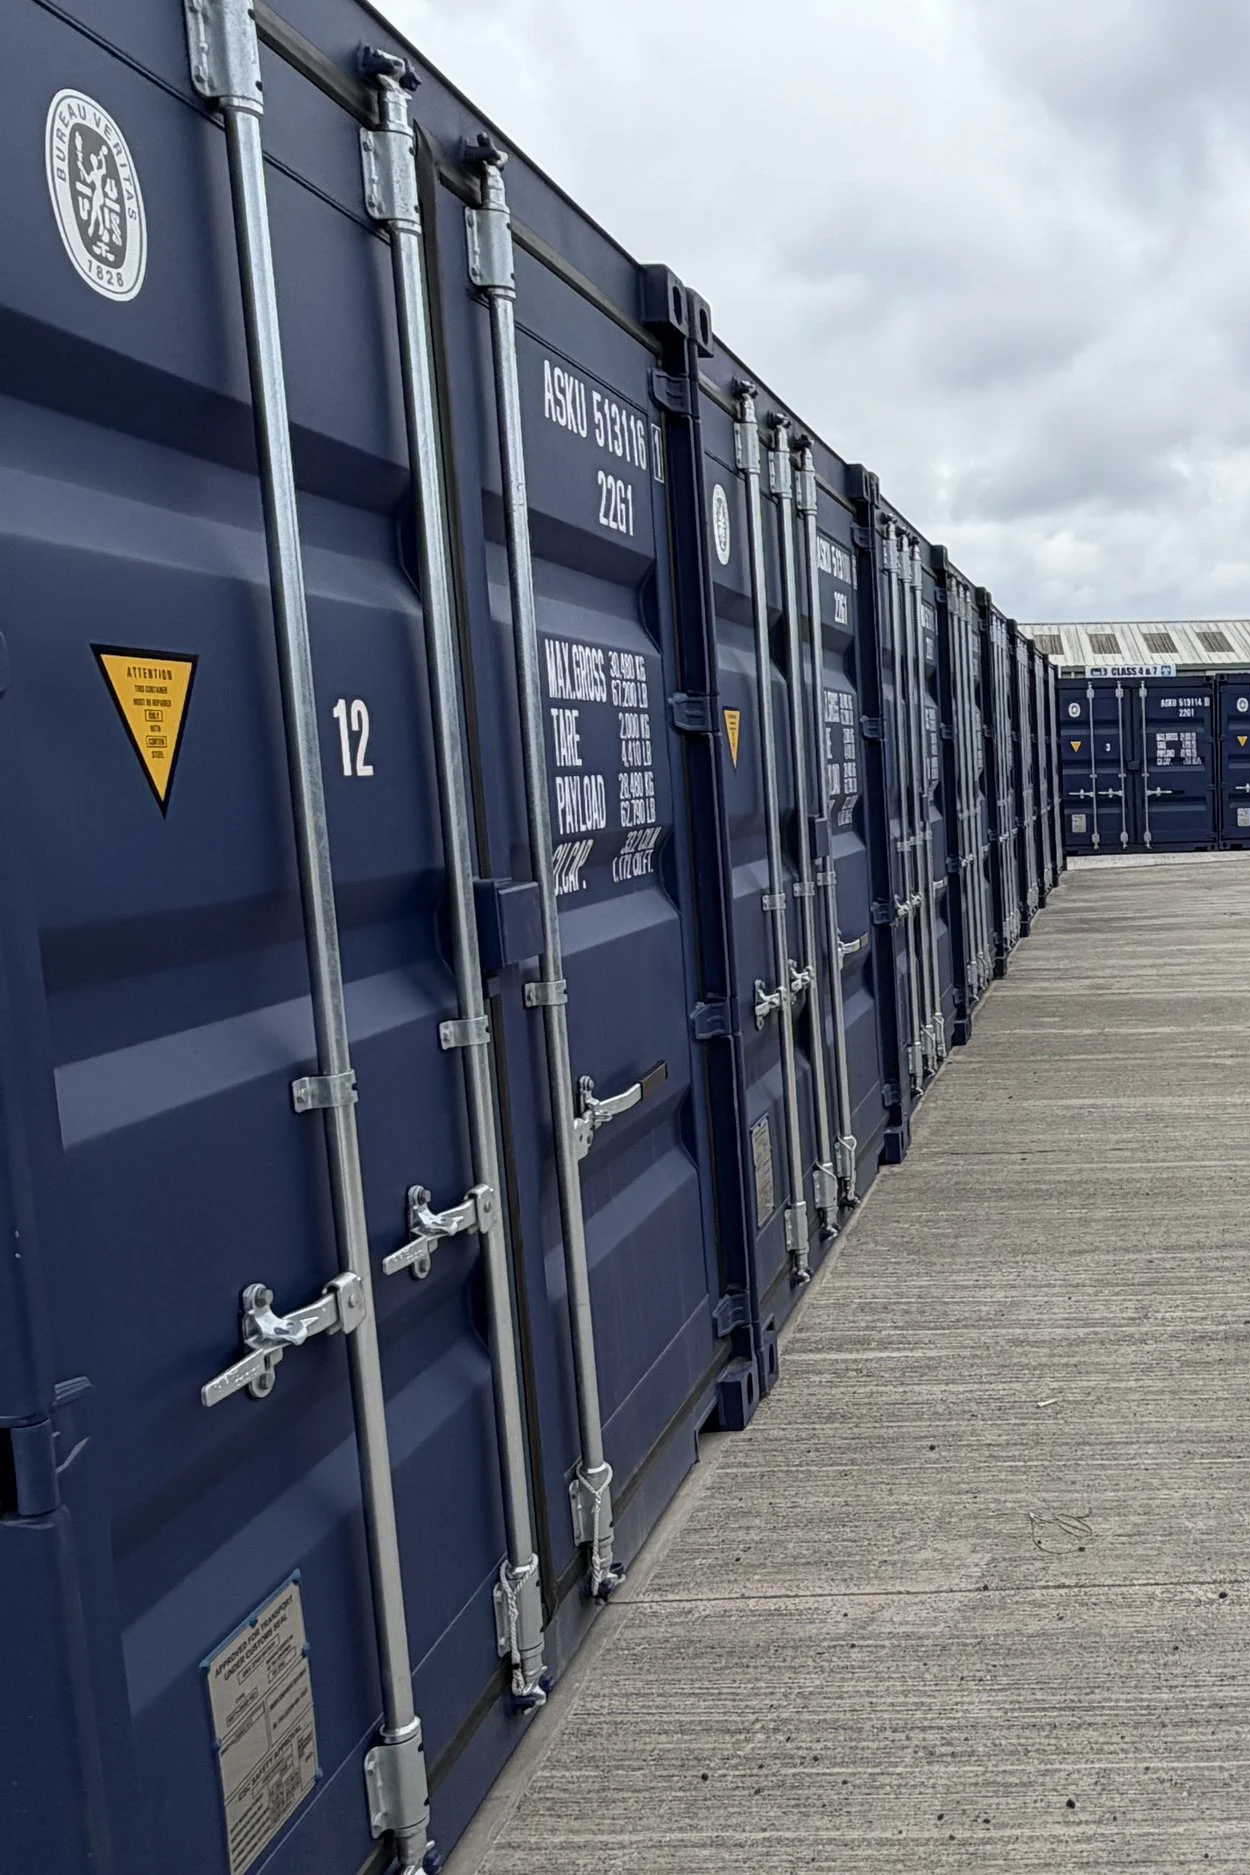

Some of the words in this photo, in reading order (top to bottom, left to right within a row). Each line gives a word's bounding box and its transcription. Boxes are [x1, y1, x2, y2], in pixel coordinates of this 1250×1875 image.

[54, 103, 88, 182] BUREAU
[92, 111, 137, 221] VERITAS
[86, 259, 124, 287] 1828
[543, 359, 587, 438] ASKU
[592, 390, 647, 470] 513116
[653, 430, 662, 479] 1
[597, 470, 634, 536] 22G1
[127, 667, 172, 680] ATTENTION
[1111, 667, 1137, 676] CLASS
[1139, 667, 1144, 676] 4
[1153, 666, 1158, 676] 7
[637, 682, 648, 708] LB
[332, 698, 374, 776] 12
[551, 708, 582, 767] TARE
[1105, 743, 1111, 752] 3
[642, 740, 652, 766] LB
[555, 774, 606, 834] PAYLOAD
[644, 771, 654, 797] KG
[646, 797, 656, 823] LB
